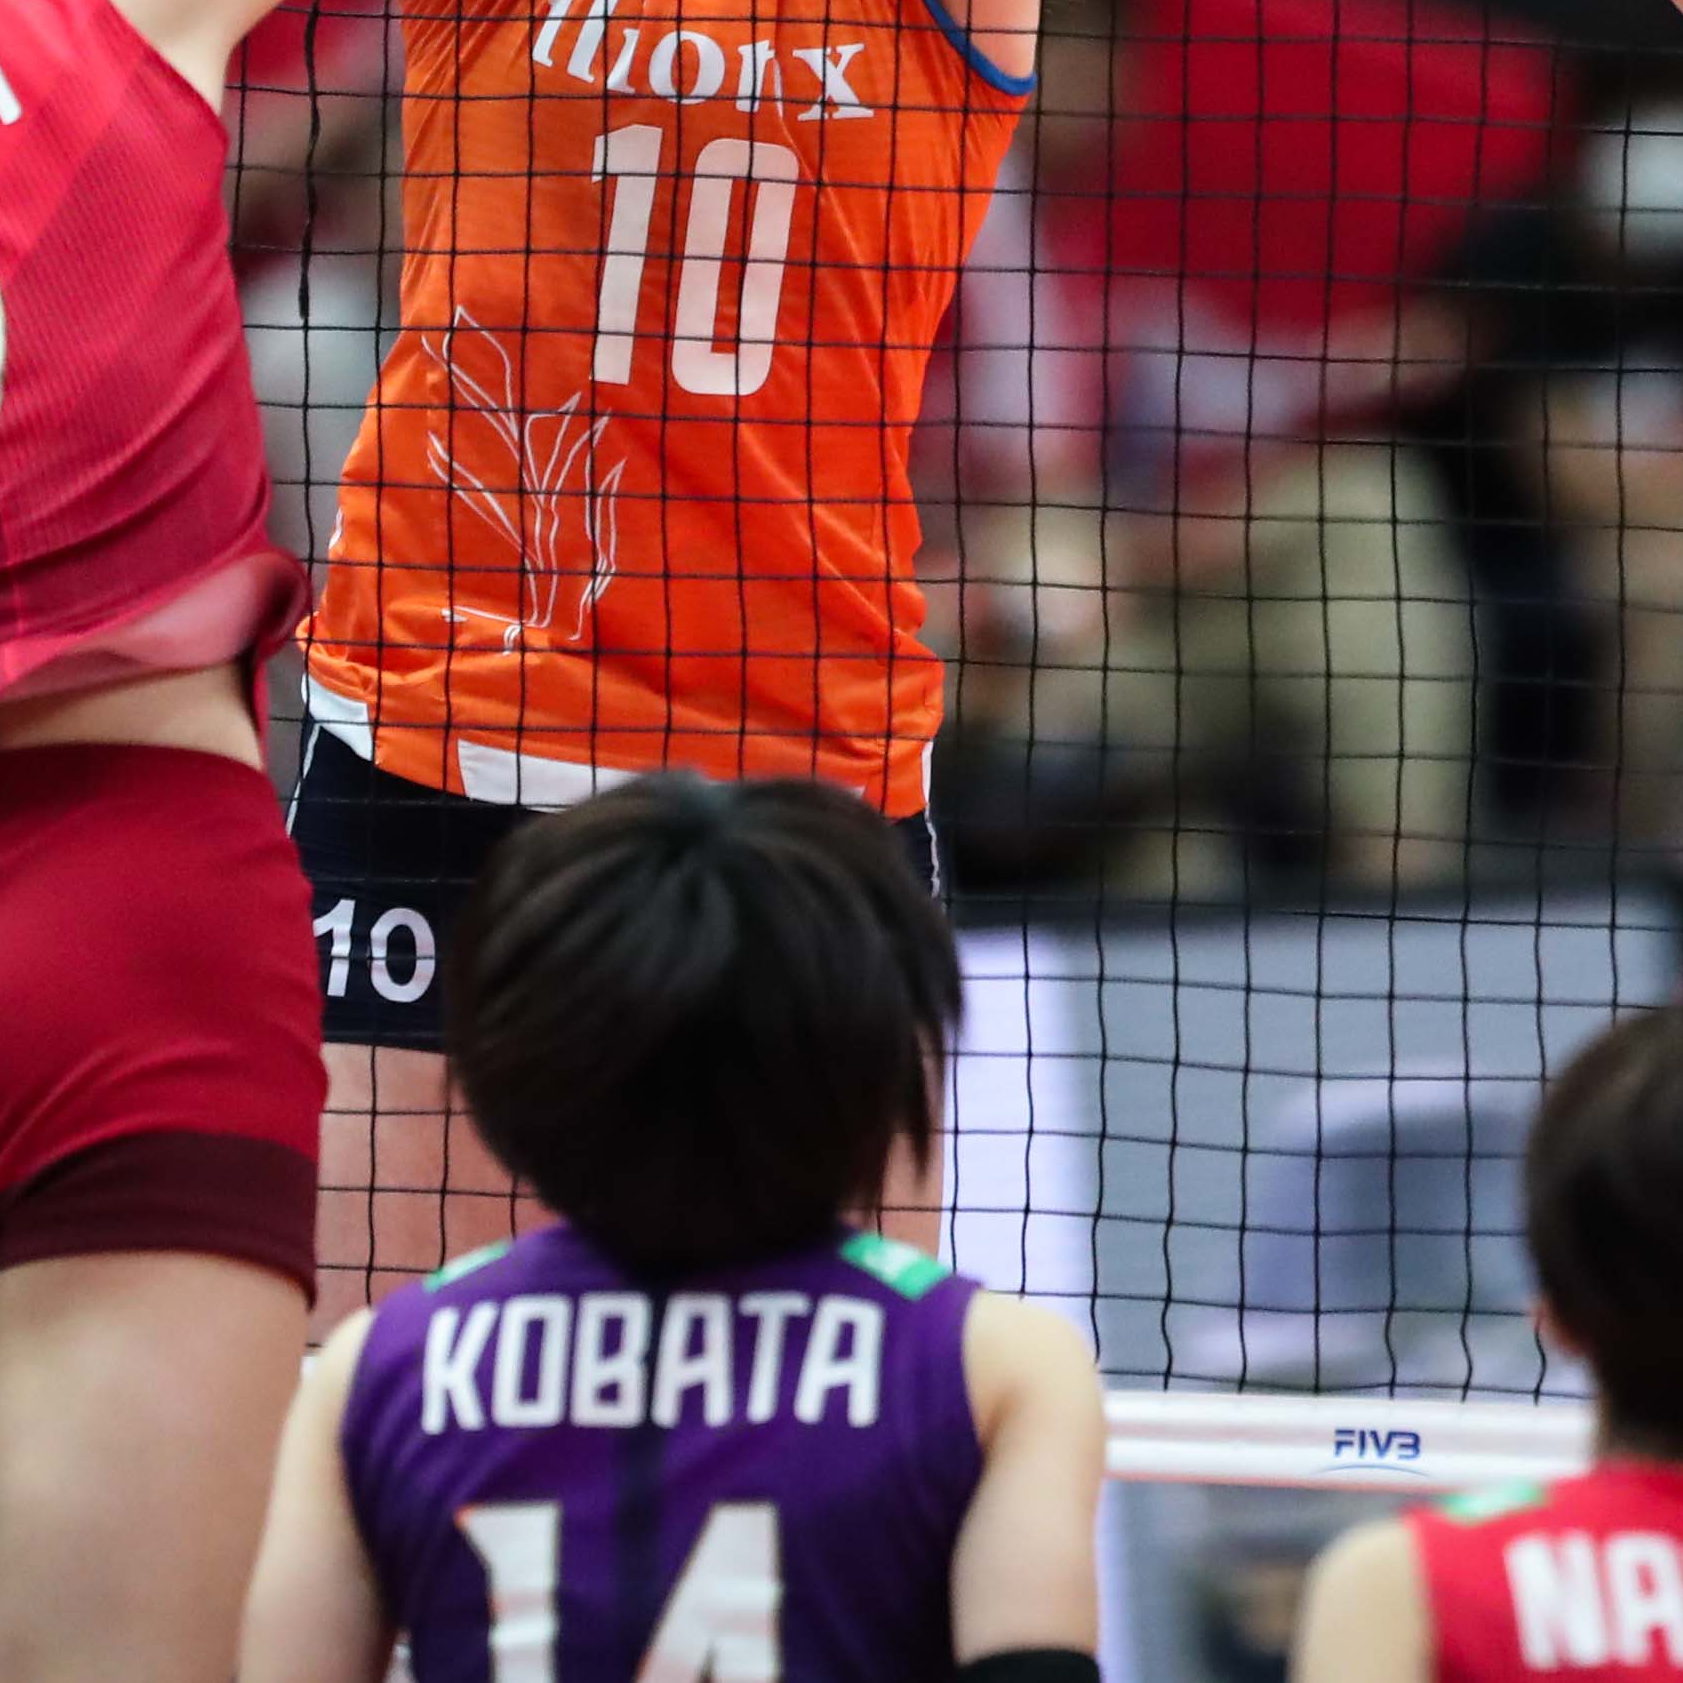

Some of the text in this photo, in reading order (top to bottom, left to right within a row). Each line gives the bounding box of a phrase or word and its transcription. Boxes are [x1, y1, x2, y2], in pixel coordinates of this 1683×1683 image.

[590, 124, 800, 397] 10
[312, 898, 436, 1003] 10
[422, 1292, 885, 1436] KOBATA
[1333, 1428, 1422, 1459] FIVB
[455, 1501, 785, 1683] 14
